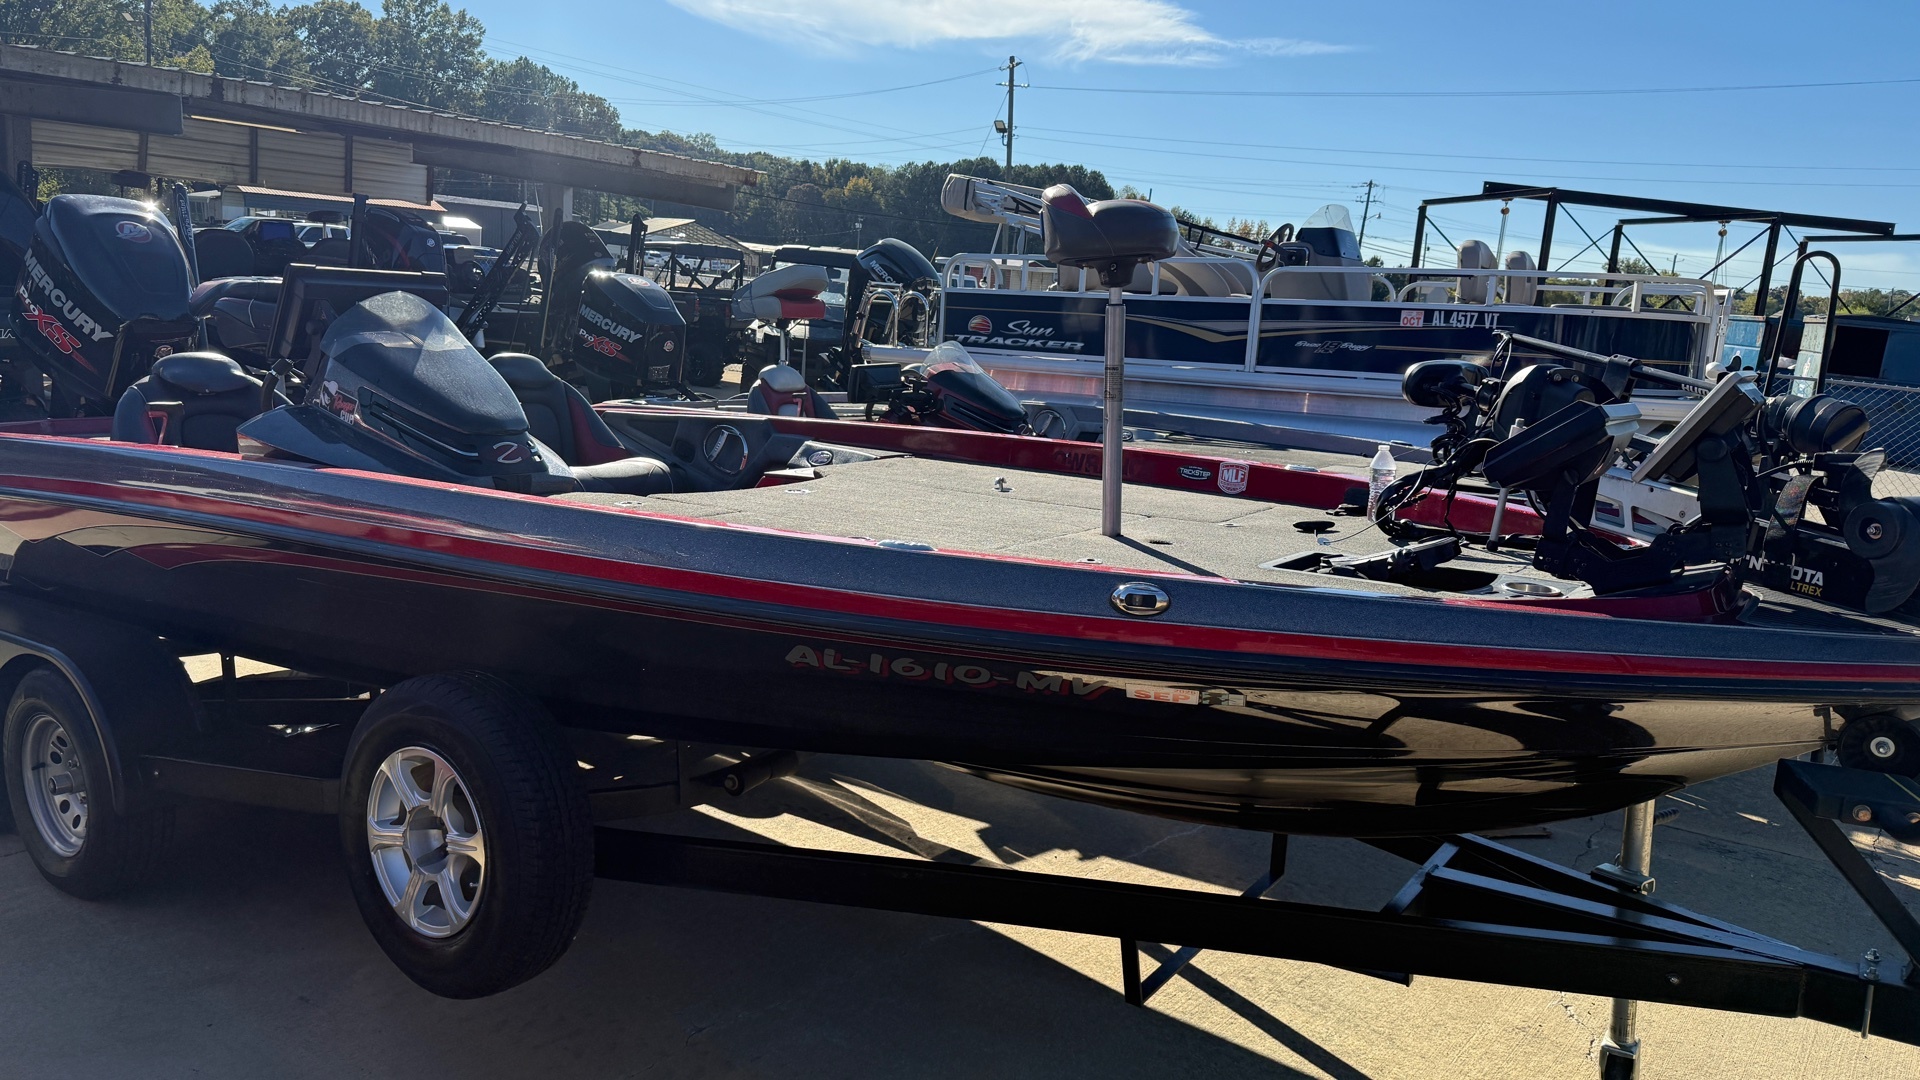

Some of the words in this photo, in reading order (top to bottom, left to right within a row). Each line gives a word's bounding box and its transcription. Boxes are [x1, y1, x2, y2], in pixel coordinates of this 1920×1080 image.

[869, 259, 897, 283] MERC
[24, 248, 114, 342] MERCURY
[579, 303, 643, 344] MERCURY
[1402, 316, 1422, 326] OCT
[1432, 310, 1446, 326] AL
[1450, 311, 1478, 328] 4517
[1484, 312, 1500, 329] VT
[1000, 320, 1056, 337] Sun
[954, 334, 1085, 351] TRACKER
[1681, 383, 1710, 396] HUM
[340, 410, 354, 425] CUP
[1223, 468, 1245, 483] MLF
[1790, 565, 1824, 587] OTA
[1790, 580, 1823, 597] LTREX
[784, 645, 1110, 697] AL-1610-MV
[1134, 689, 1191, 703] SEP
